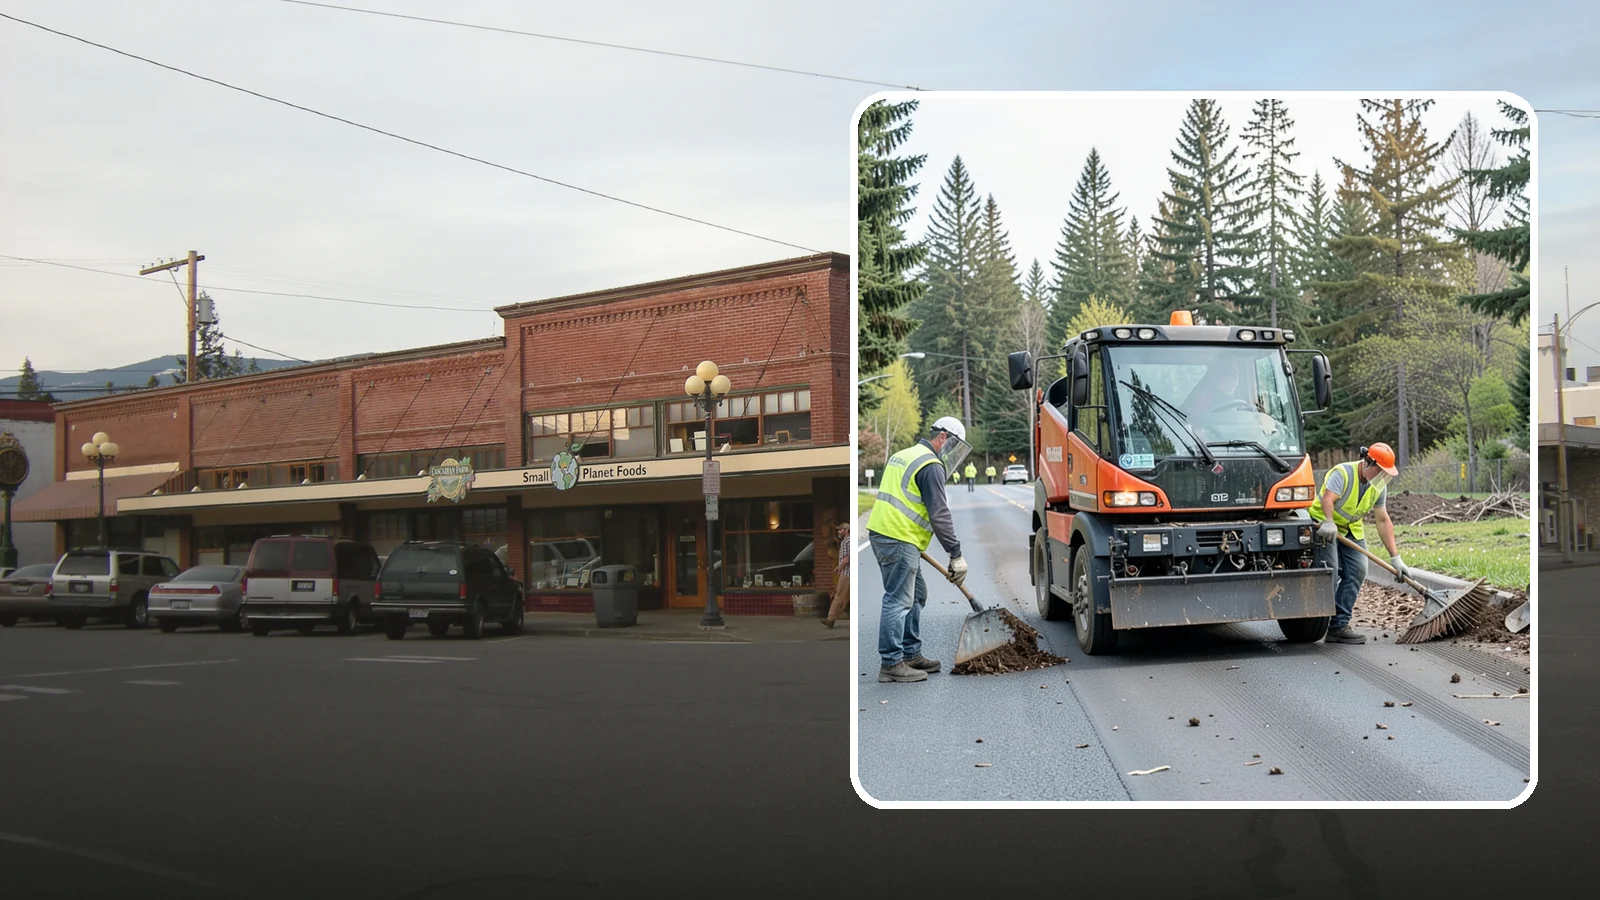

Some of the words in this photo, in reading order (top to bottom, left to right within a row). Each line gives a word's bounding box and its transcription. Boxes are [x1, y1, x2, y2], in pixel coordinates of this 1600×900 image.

[522, 471, 549, 483] Small
[582, 468, 614, 479] Planet
[616, 464, 647, 477] Foods
